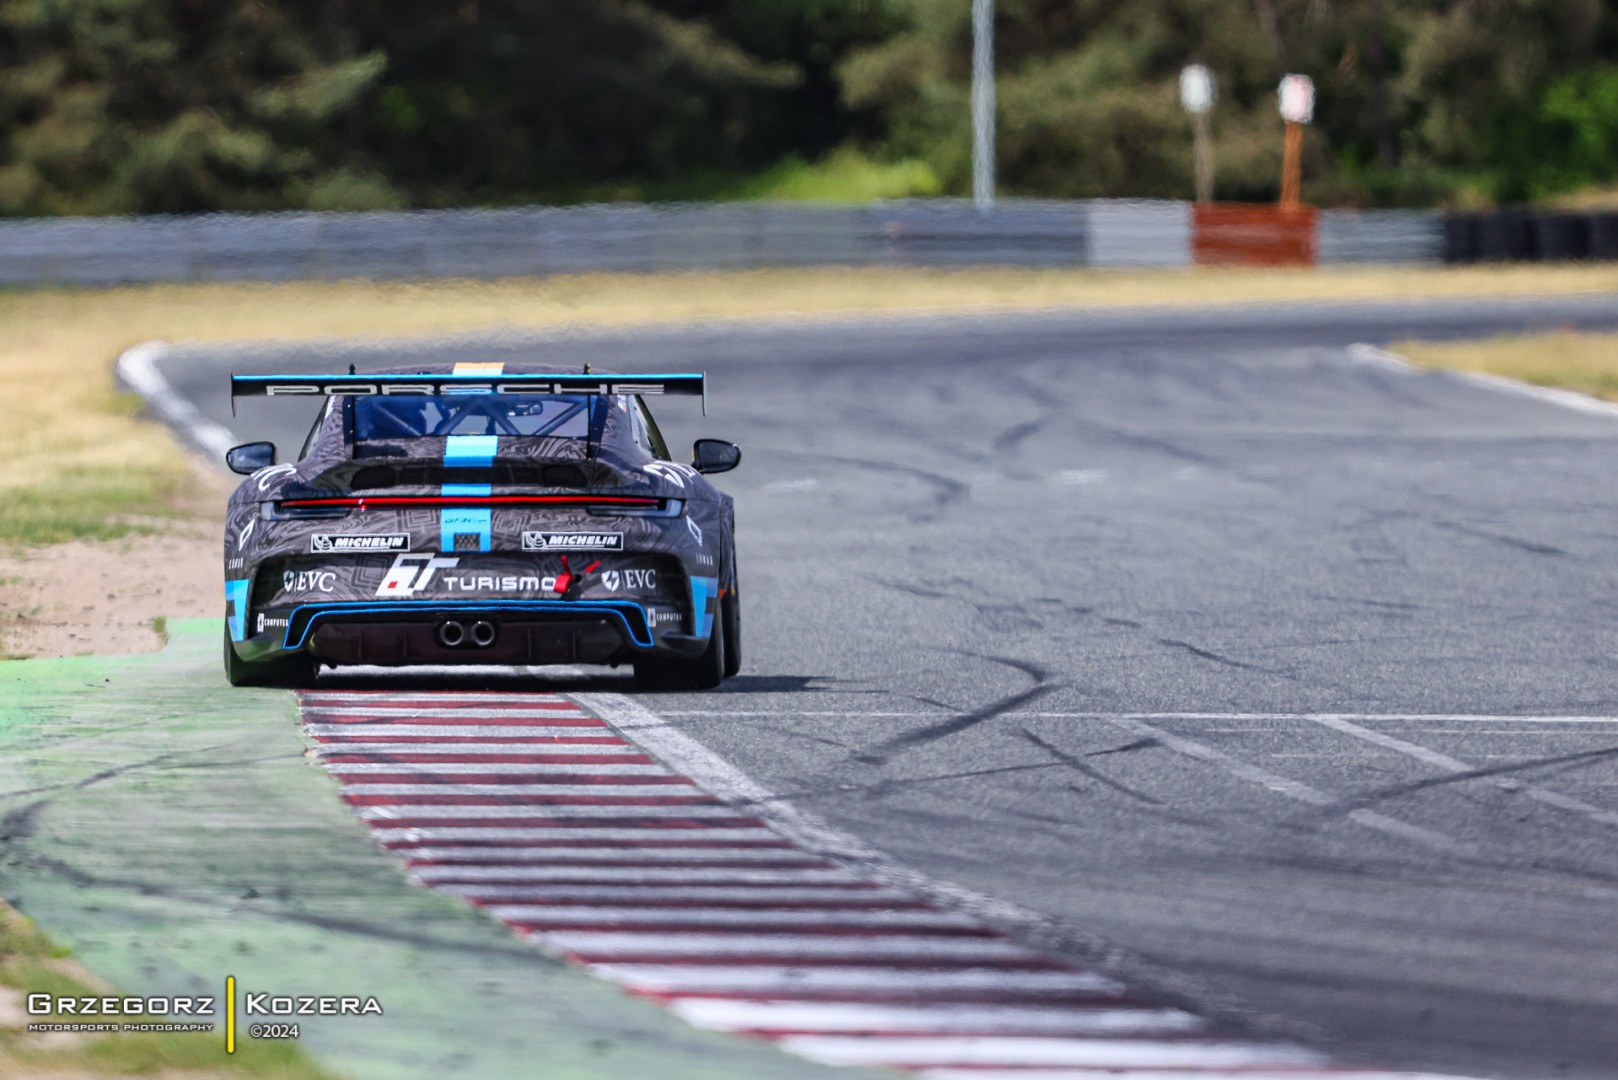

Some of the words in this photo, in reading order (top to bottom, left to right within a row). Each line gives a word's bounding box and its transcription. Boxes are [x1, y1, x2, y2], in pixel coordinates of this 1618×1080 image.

[266, 384, 664, 396] PORSCHE
[334, 536, 404, 547] MICHELIN
[547, 535, 618, 546] MICHELIN
[296, 571, 336, 592] EVC
[444, 576, 556, 591] TURISMO
[625, 569, 656, 590] EVC
